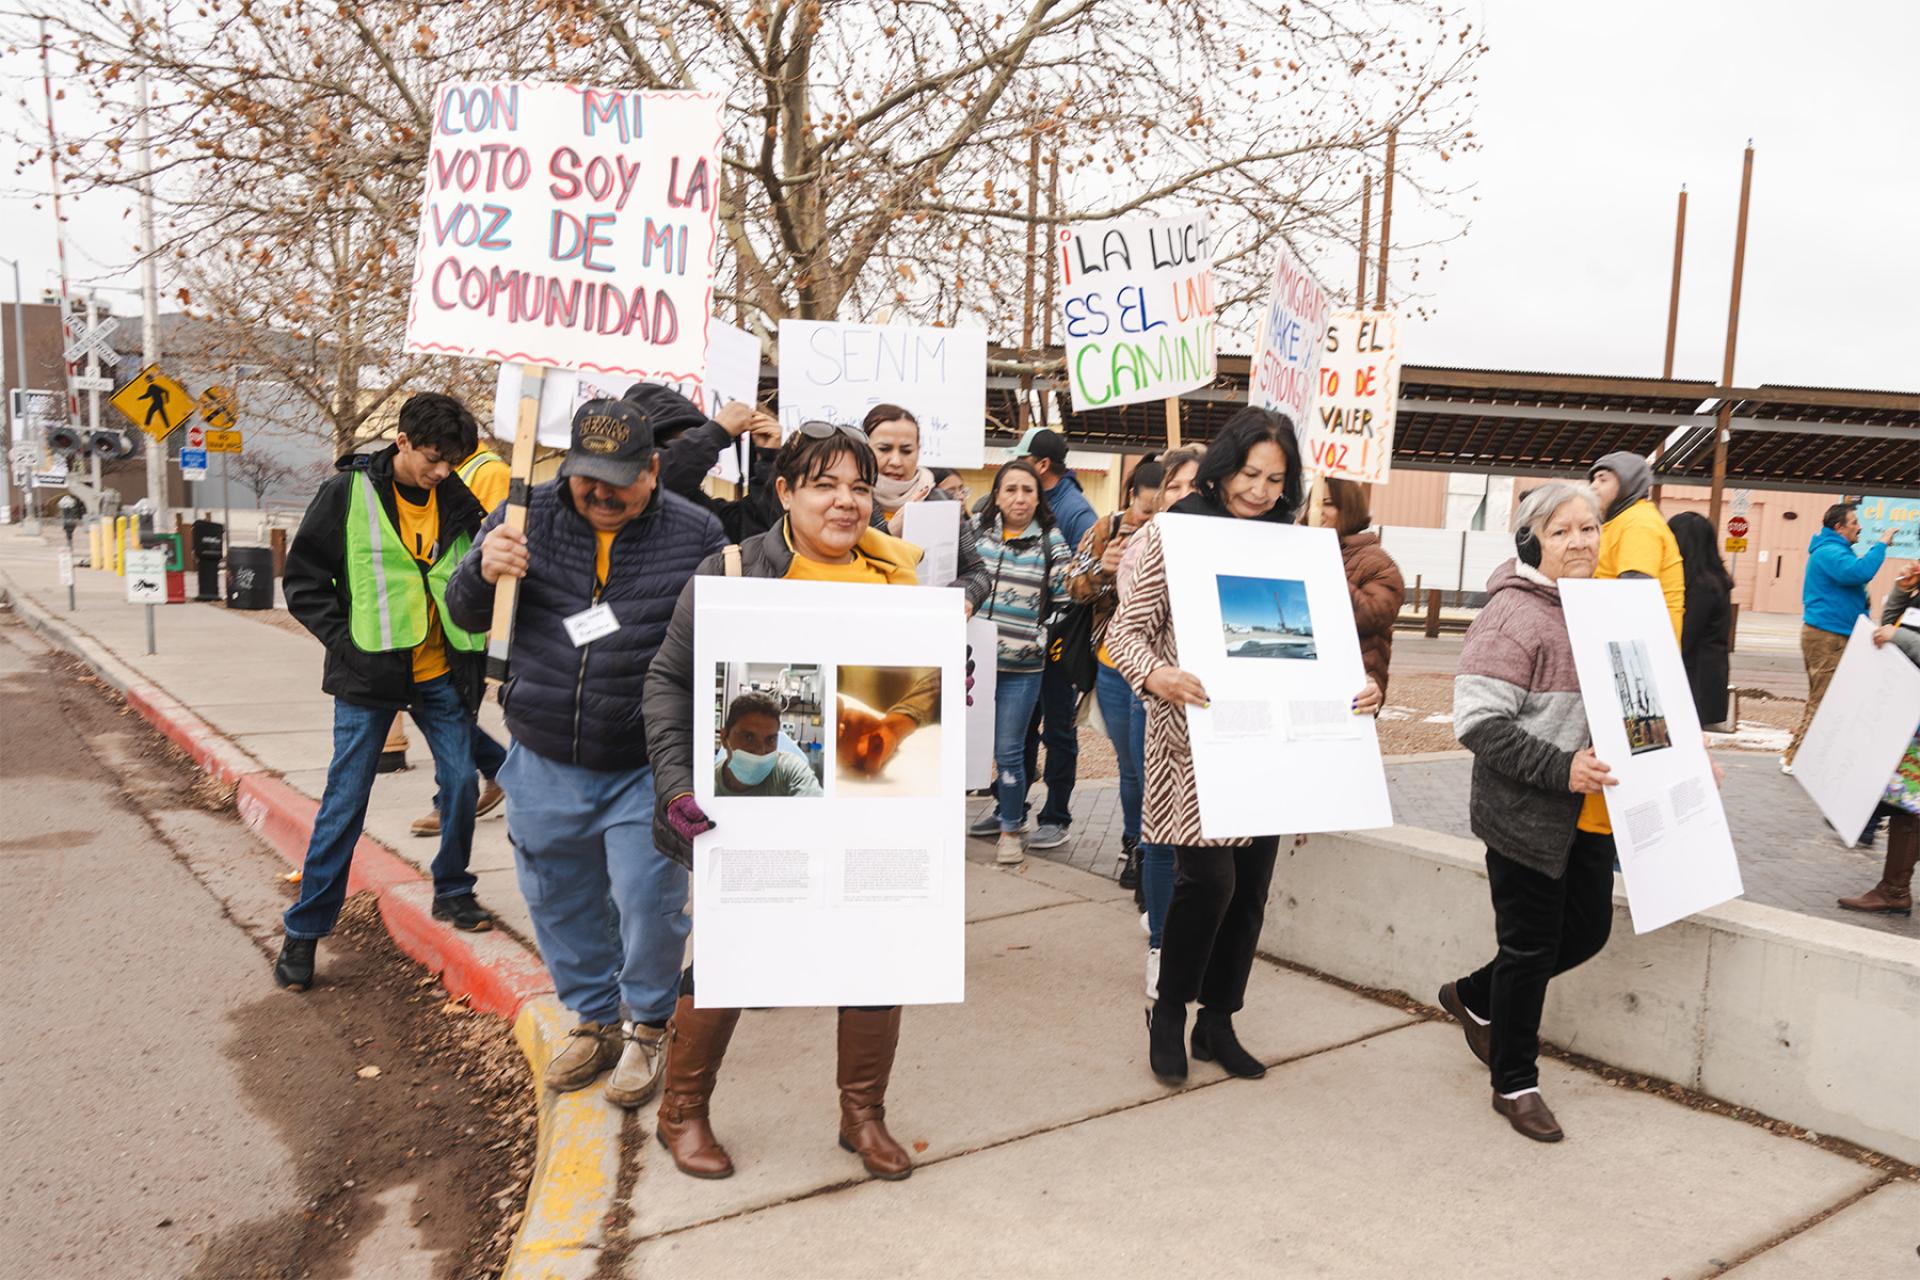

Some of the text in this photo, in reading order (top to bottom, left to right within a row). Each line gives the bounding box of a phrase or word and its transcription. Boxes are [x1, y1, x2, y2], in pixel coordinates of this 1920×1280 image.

[440, 85, 643, 144] CON MI
[435, 144, 710, 212] VOTO SOY LA
[431, 202, 688, 276] VOZ DE MI
[432, 256, 678, 345] COMUNIDAD
[1065, 293, 1109, 337] ES
[1117, 286, 1168, 333] EL
[806, 326, 945, 386] SENM
[1269, 300, 1300, 361] MAKE
[1326, 326, 1338, 353] S
[1357, 319, 1384, 353] EL
[1319, 366, 1376, 397] TO DE
[1319, 405, 1374, 438] VALER
